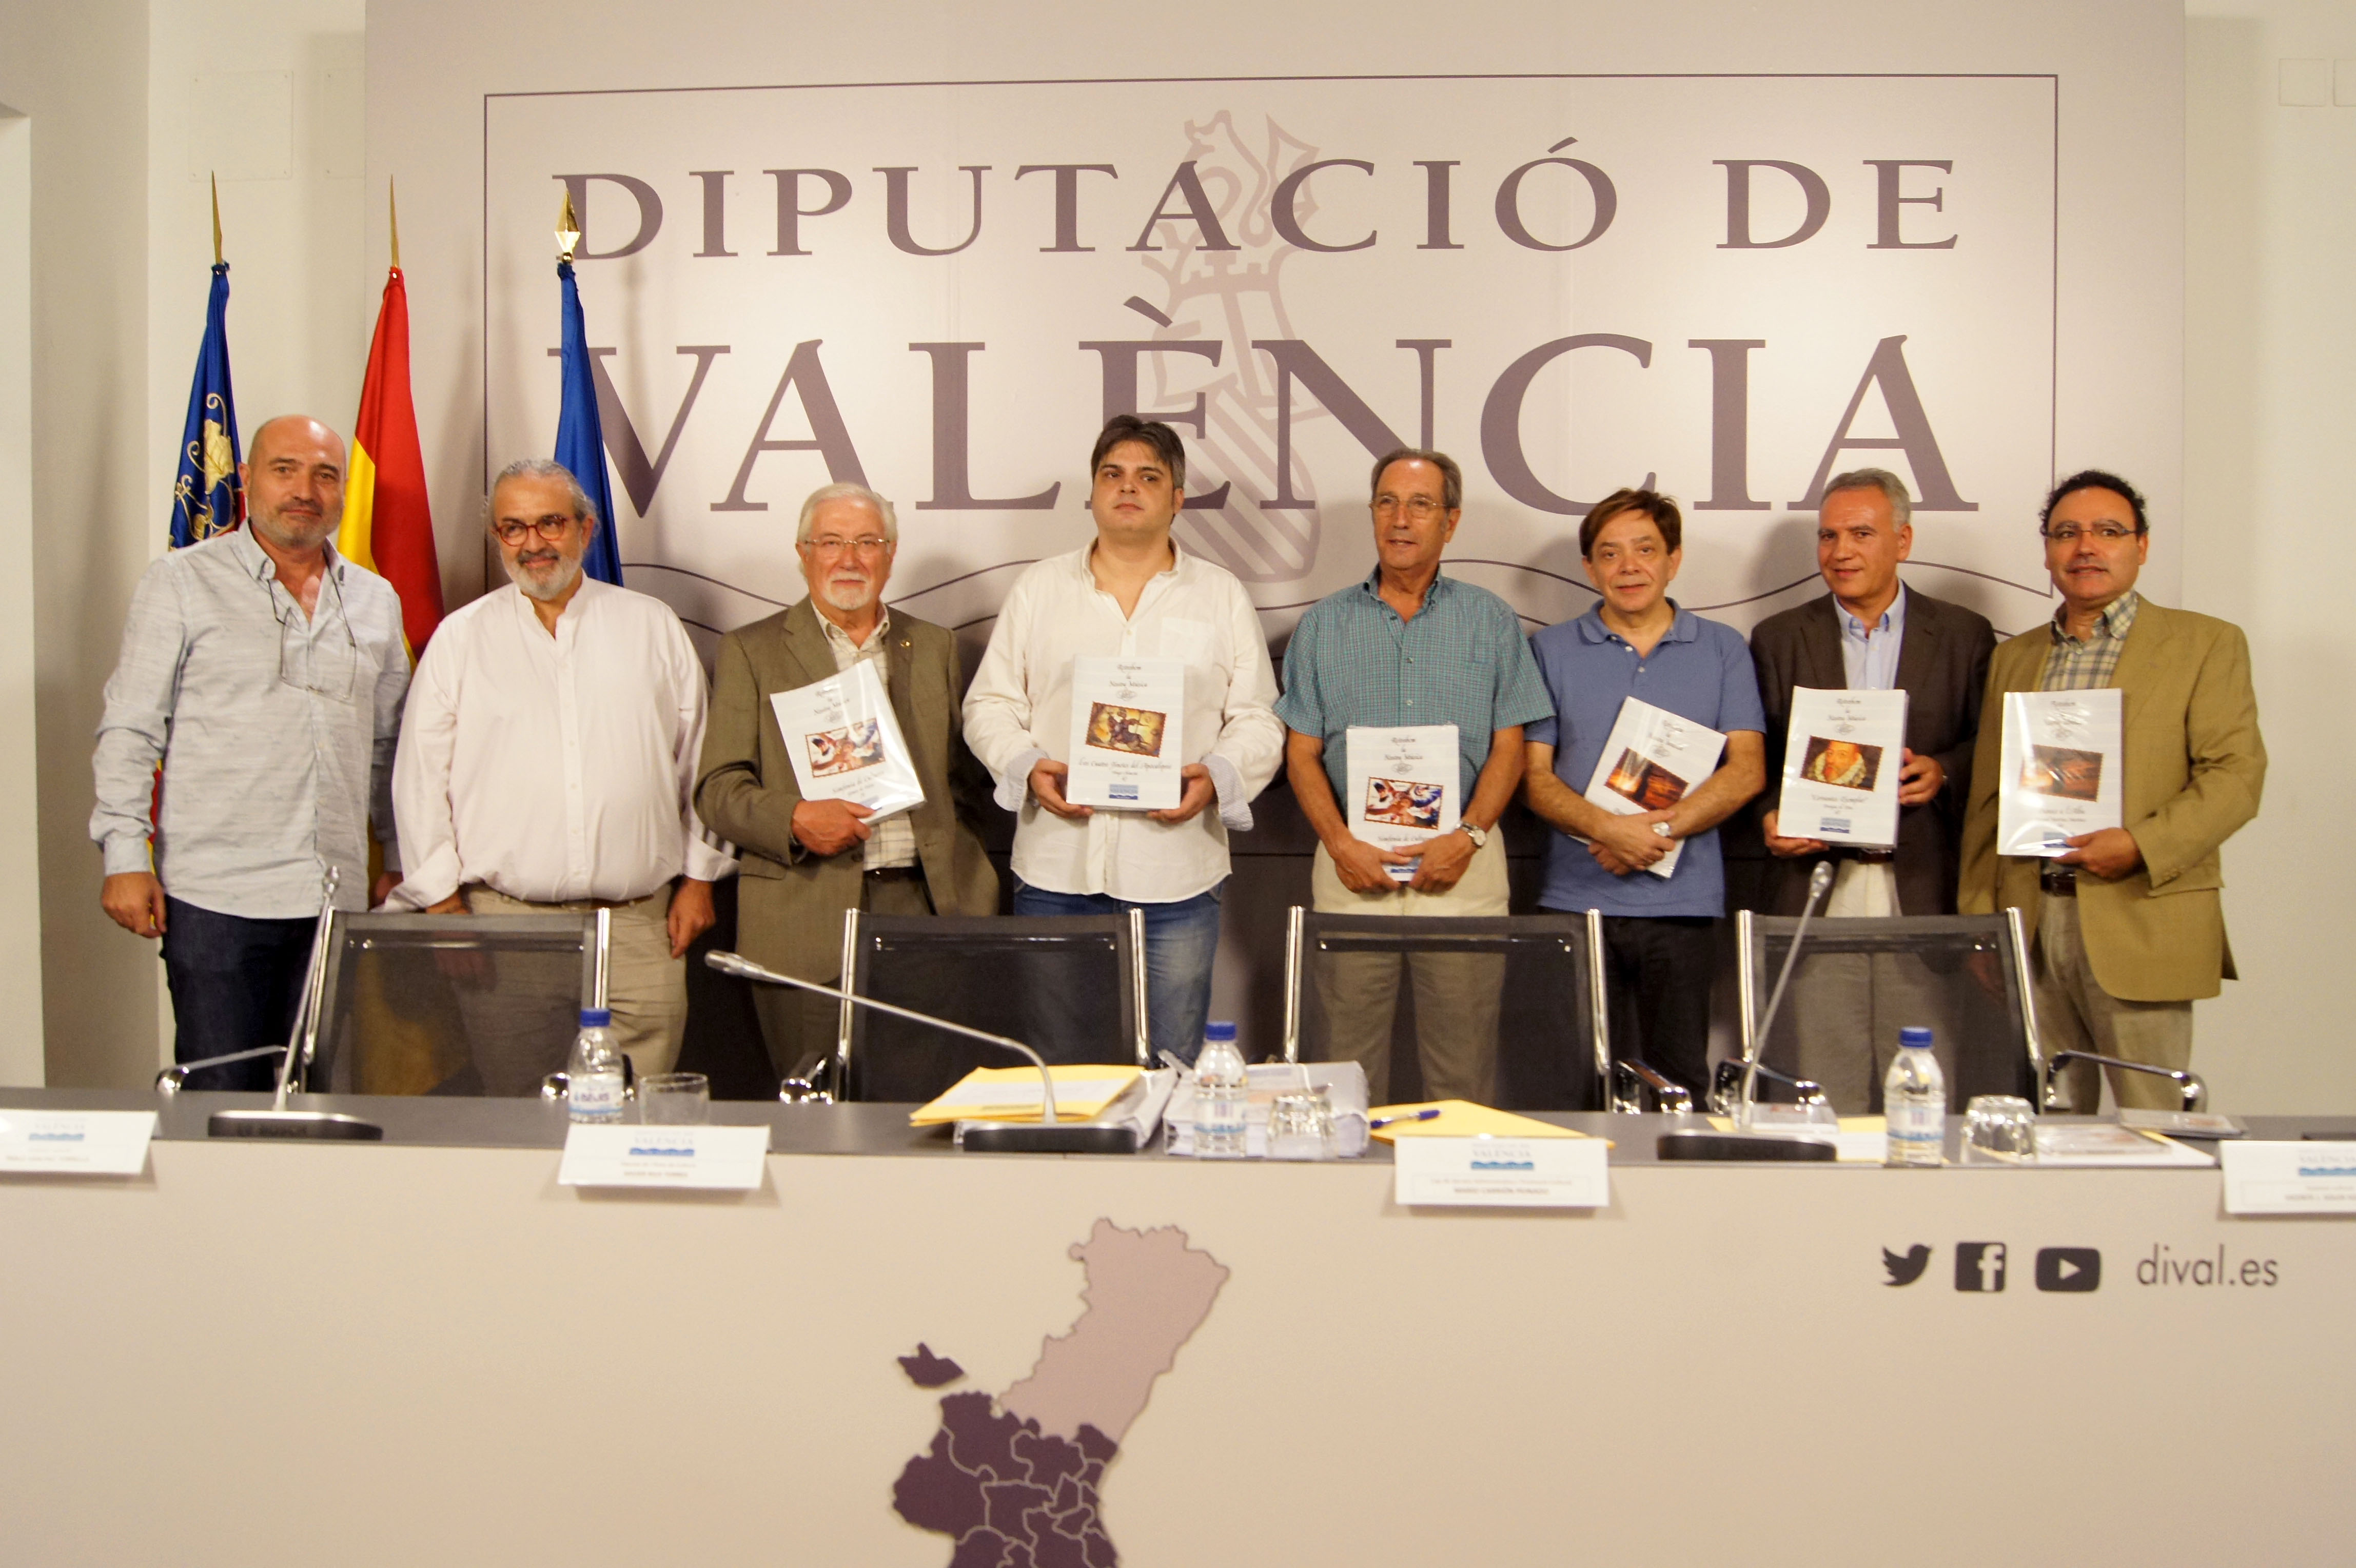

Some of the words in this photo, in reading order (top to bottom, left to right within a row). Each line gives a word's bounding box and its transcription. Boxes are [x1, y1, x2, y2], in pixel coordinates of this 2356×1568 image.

[552, 136, 1618, 260] DIPUTACIÓ
[1712, 159, 1959, 250] DE
[547, 295, 1979, 518] VALÈNCIA
[2136, 1243, 2279, 1286] dival.es
